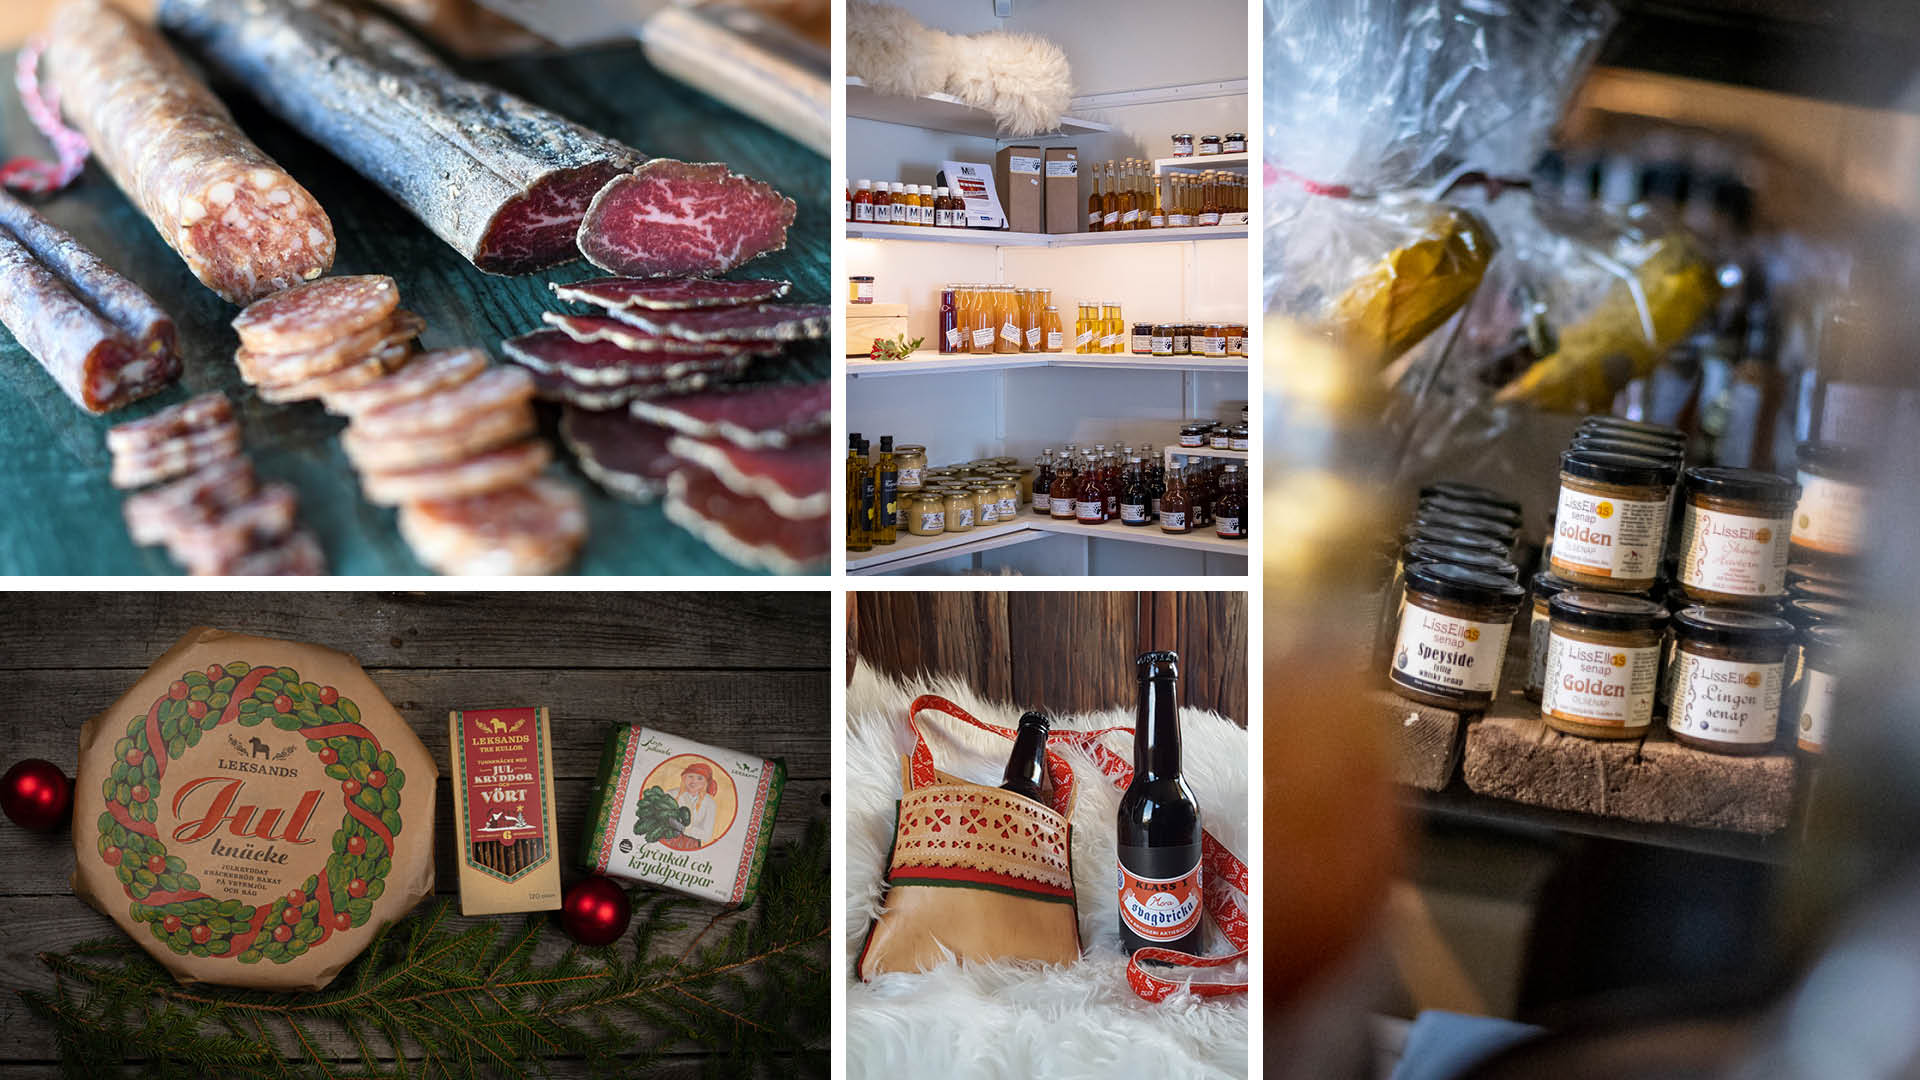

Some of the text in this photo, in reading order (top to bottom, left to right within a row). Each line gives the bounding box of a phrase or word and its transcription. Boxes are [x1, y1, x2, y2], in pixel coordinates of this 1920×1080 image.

[1572, 511, 1597, 524] senap
[1560, 521, 1612, 546] Golden
[1423, 615, 1480, 641] LissEllas
[1434, 633, 1465, 648] senap
[1418, 642, 1474, 668] Speyside
[1568, 646, 1626, 667] LissEllas
[1580, 664, 1612, 676] senap
[1563, 674, 1625, 697] Golden
[1701, 684, 1756, 710] Lingon
[1706, 708, 1749, 728] senap
[472, 735, 529, 745] LEKSANDS
[218, 759, 298, 777] LEKSANDS
[493, 765, 514, 776] JUL
[474, 773, 533, 784] KRYDDOR
[481, 787, 528, 803] VÖRT
[172, 776, 325, 845] Jul
[503, 830, 512, 840] 6
[211, 838, 289, 865] knäcke
[628, 856, 714, 888] kryddpeppar
[690, 859, 713, 874] och
[1136, 880, 1177, 891] KLASS
[1150, 896, 1175, 907] Mora
[1131, 902, 1193, 926] svagdricka
